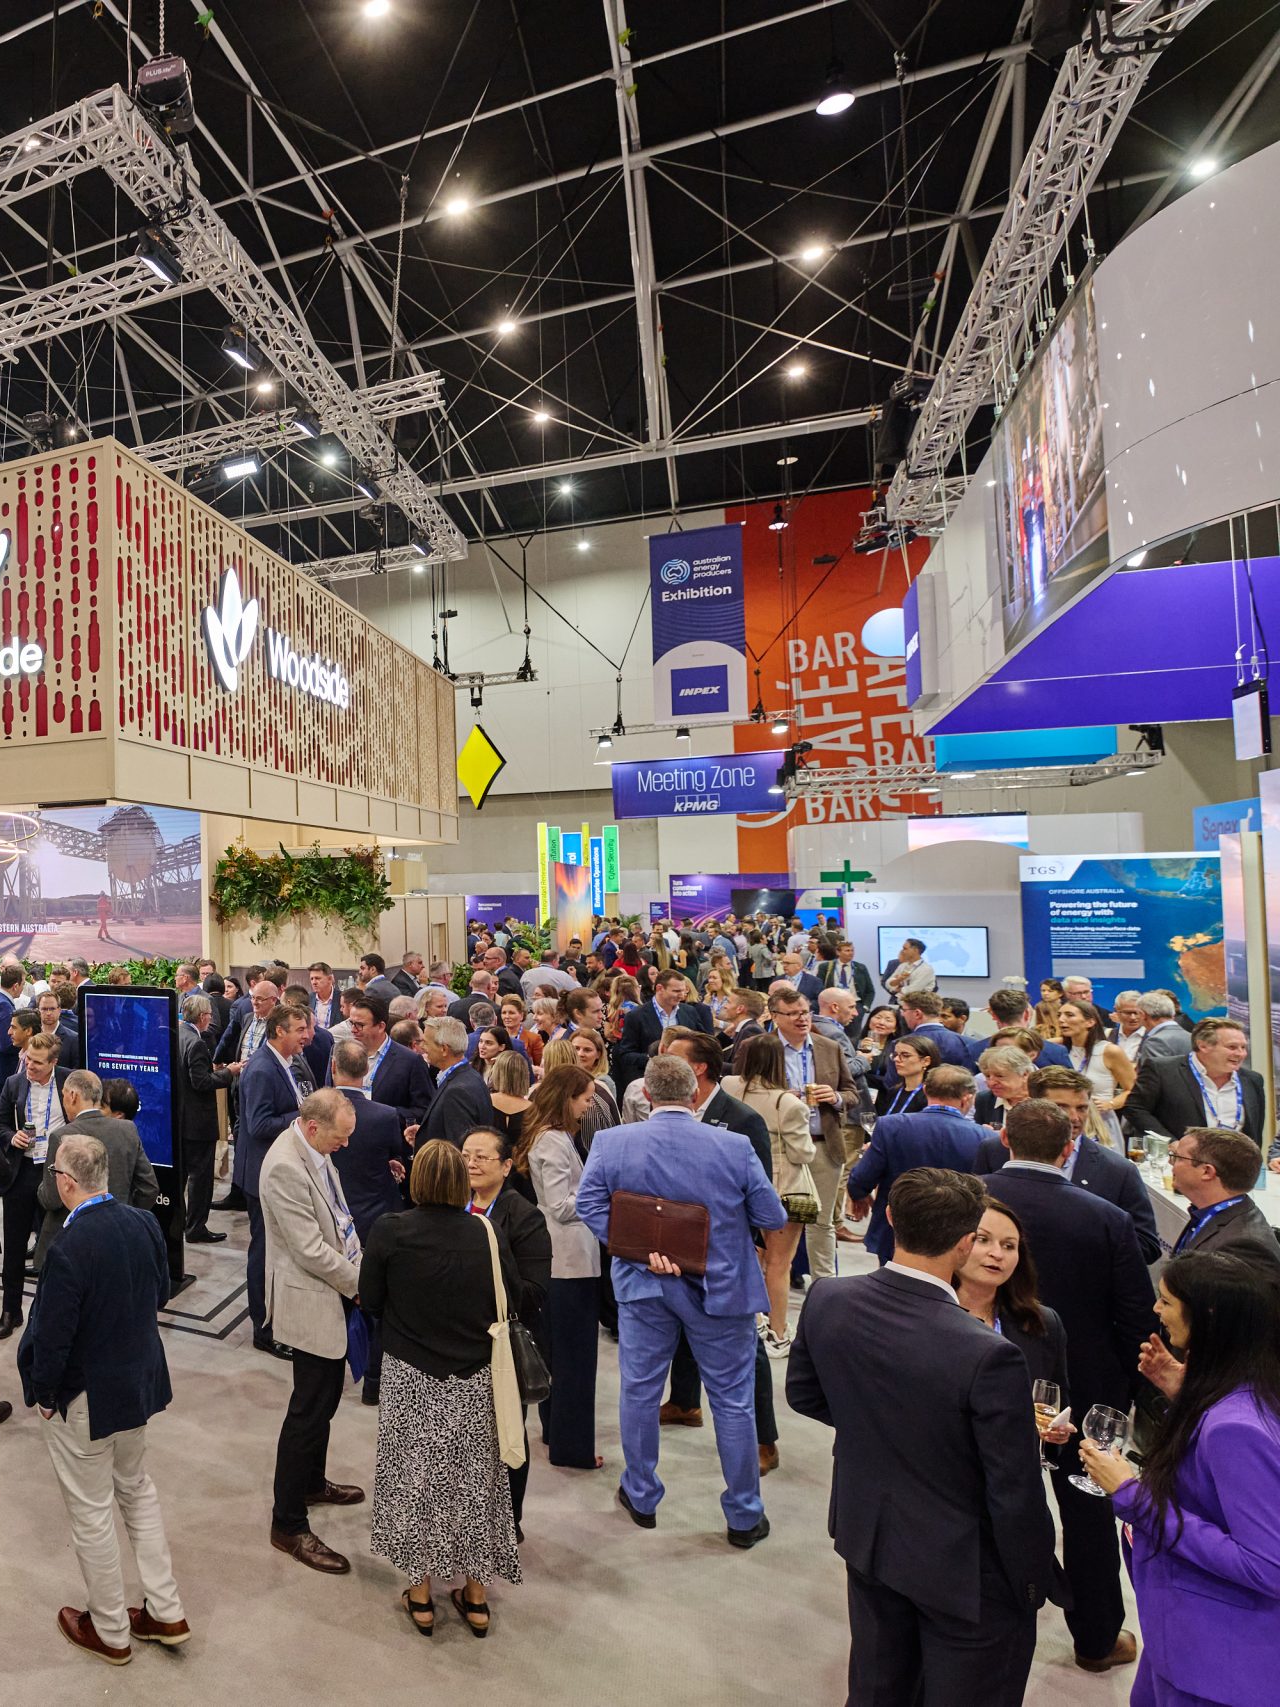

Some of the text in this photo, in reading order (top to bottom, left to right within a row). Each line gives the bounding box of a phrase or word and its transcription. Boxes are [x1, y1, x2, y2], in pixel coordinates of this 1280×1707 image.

[692, 555, 732, 566] australian
[693, 563, 720, 572] energy
[693, 568, 732, 580] producers
[661, 585, 732, 602] Exhibition
[788, 631, 859, 674] BAR
[265, 626, 349, 710] Woodside
[678, 685, 720, 697] INPEX
[637, 765, 756, 793] Meeting Zone
[673, 799, 719, 812] KPMG
[568, 852, 577, 865] rol
[593, 847, 601, 878] Operations
[1027, 866, 1056, 875] TGS
[853, 901, 880, 910] TGS
[1049, 901, 1092, 909] Powering
[1109, 900, 1138, 908] future
[1061, 909, 1093, 917] energy
[1090, 916, 1126, 924] insights
[20, 922, 58, 933] AUSTRALIA
[98, 1061, 109, 1069] FOR
[111, 1063, 138, 1071] SEVENTY
